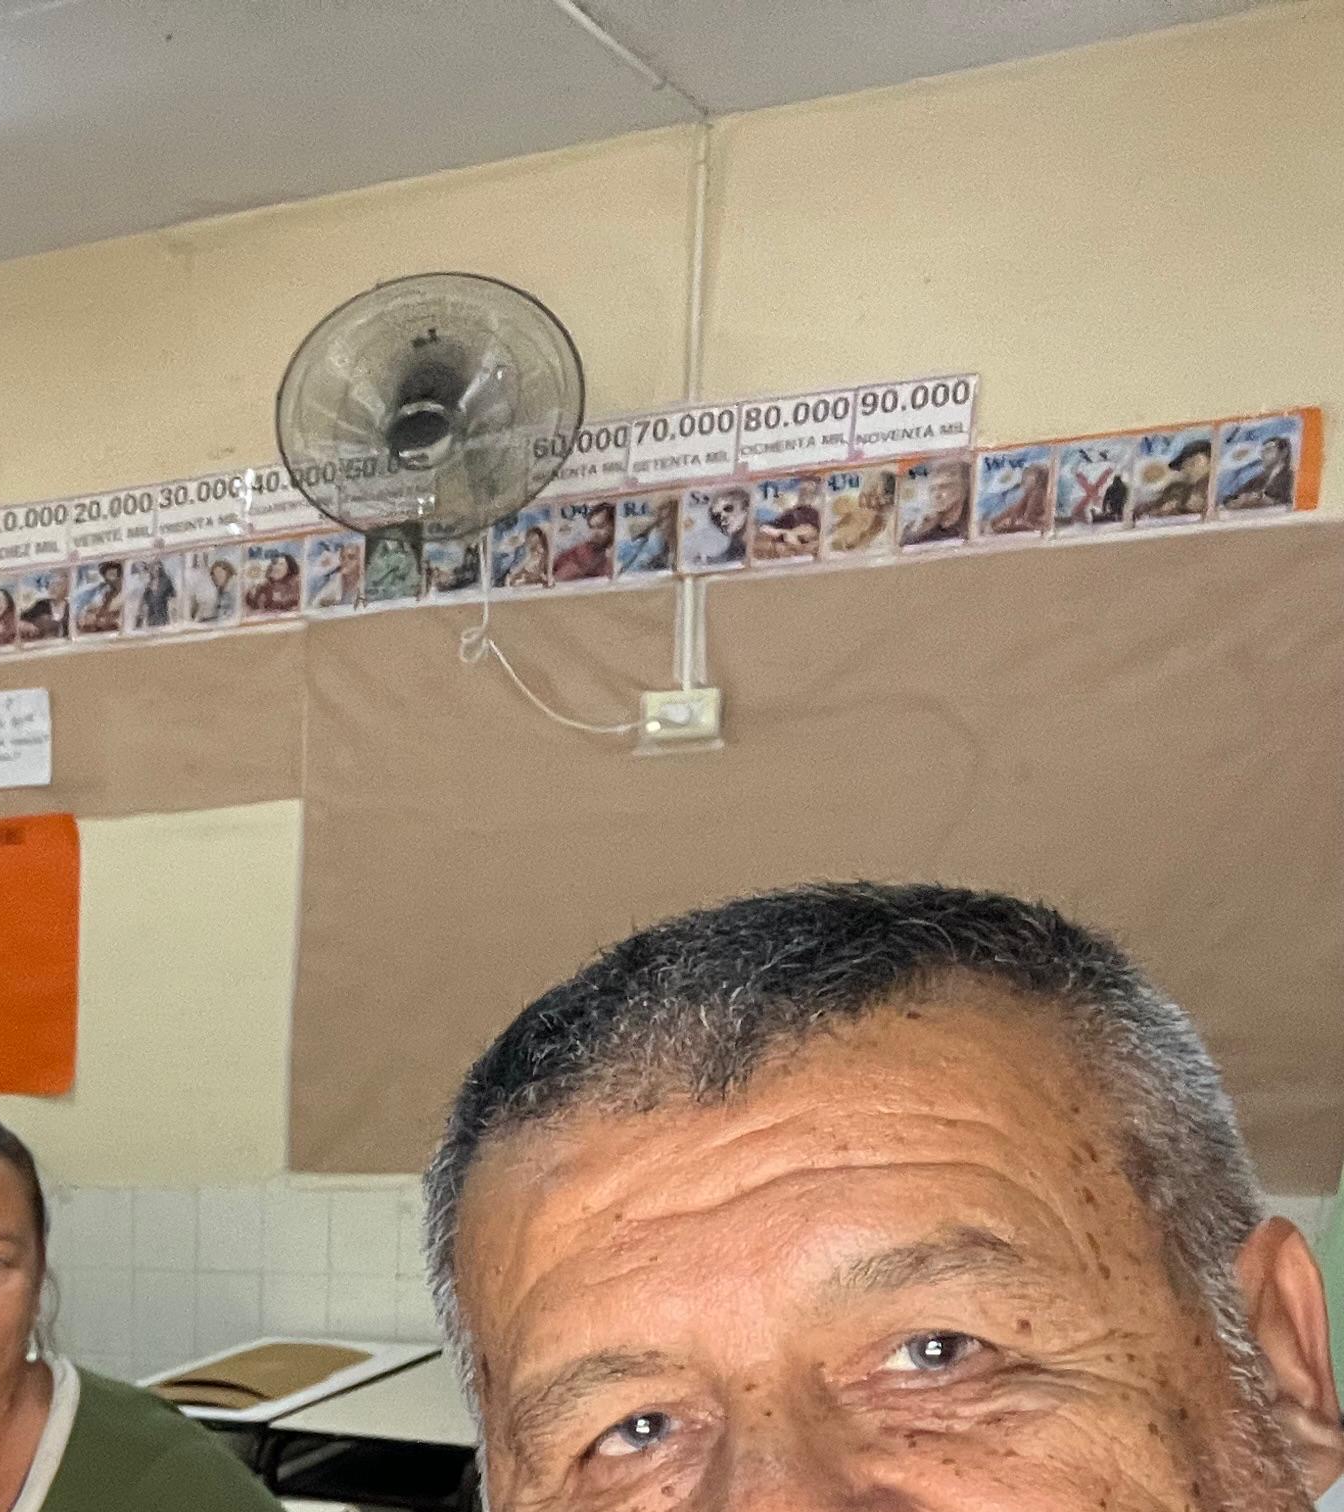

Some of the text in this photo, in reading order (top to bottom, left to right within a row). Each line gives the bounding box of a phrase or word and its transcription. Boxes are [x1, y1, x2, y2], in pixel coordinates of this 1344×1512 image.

[743, 396, 851, 432] 80.000
[861, 379, 971, 417] 90.000
[533, 424, 630, 459] 60000
[634, 409, 736, 446] 70.000
[856, 424, 935, 446] NOVENTA
[74, 491, 153, 525] 20.000
[159, 476, 243, 510] 30.000
